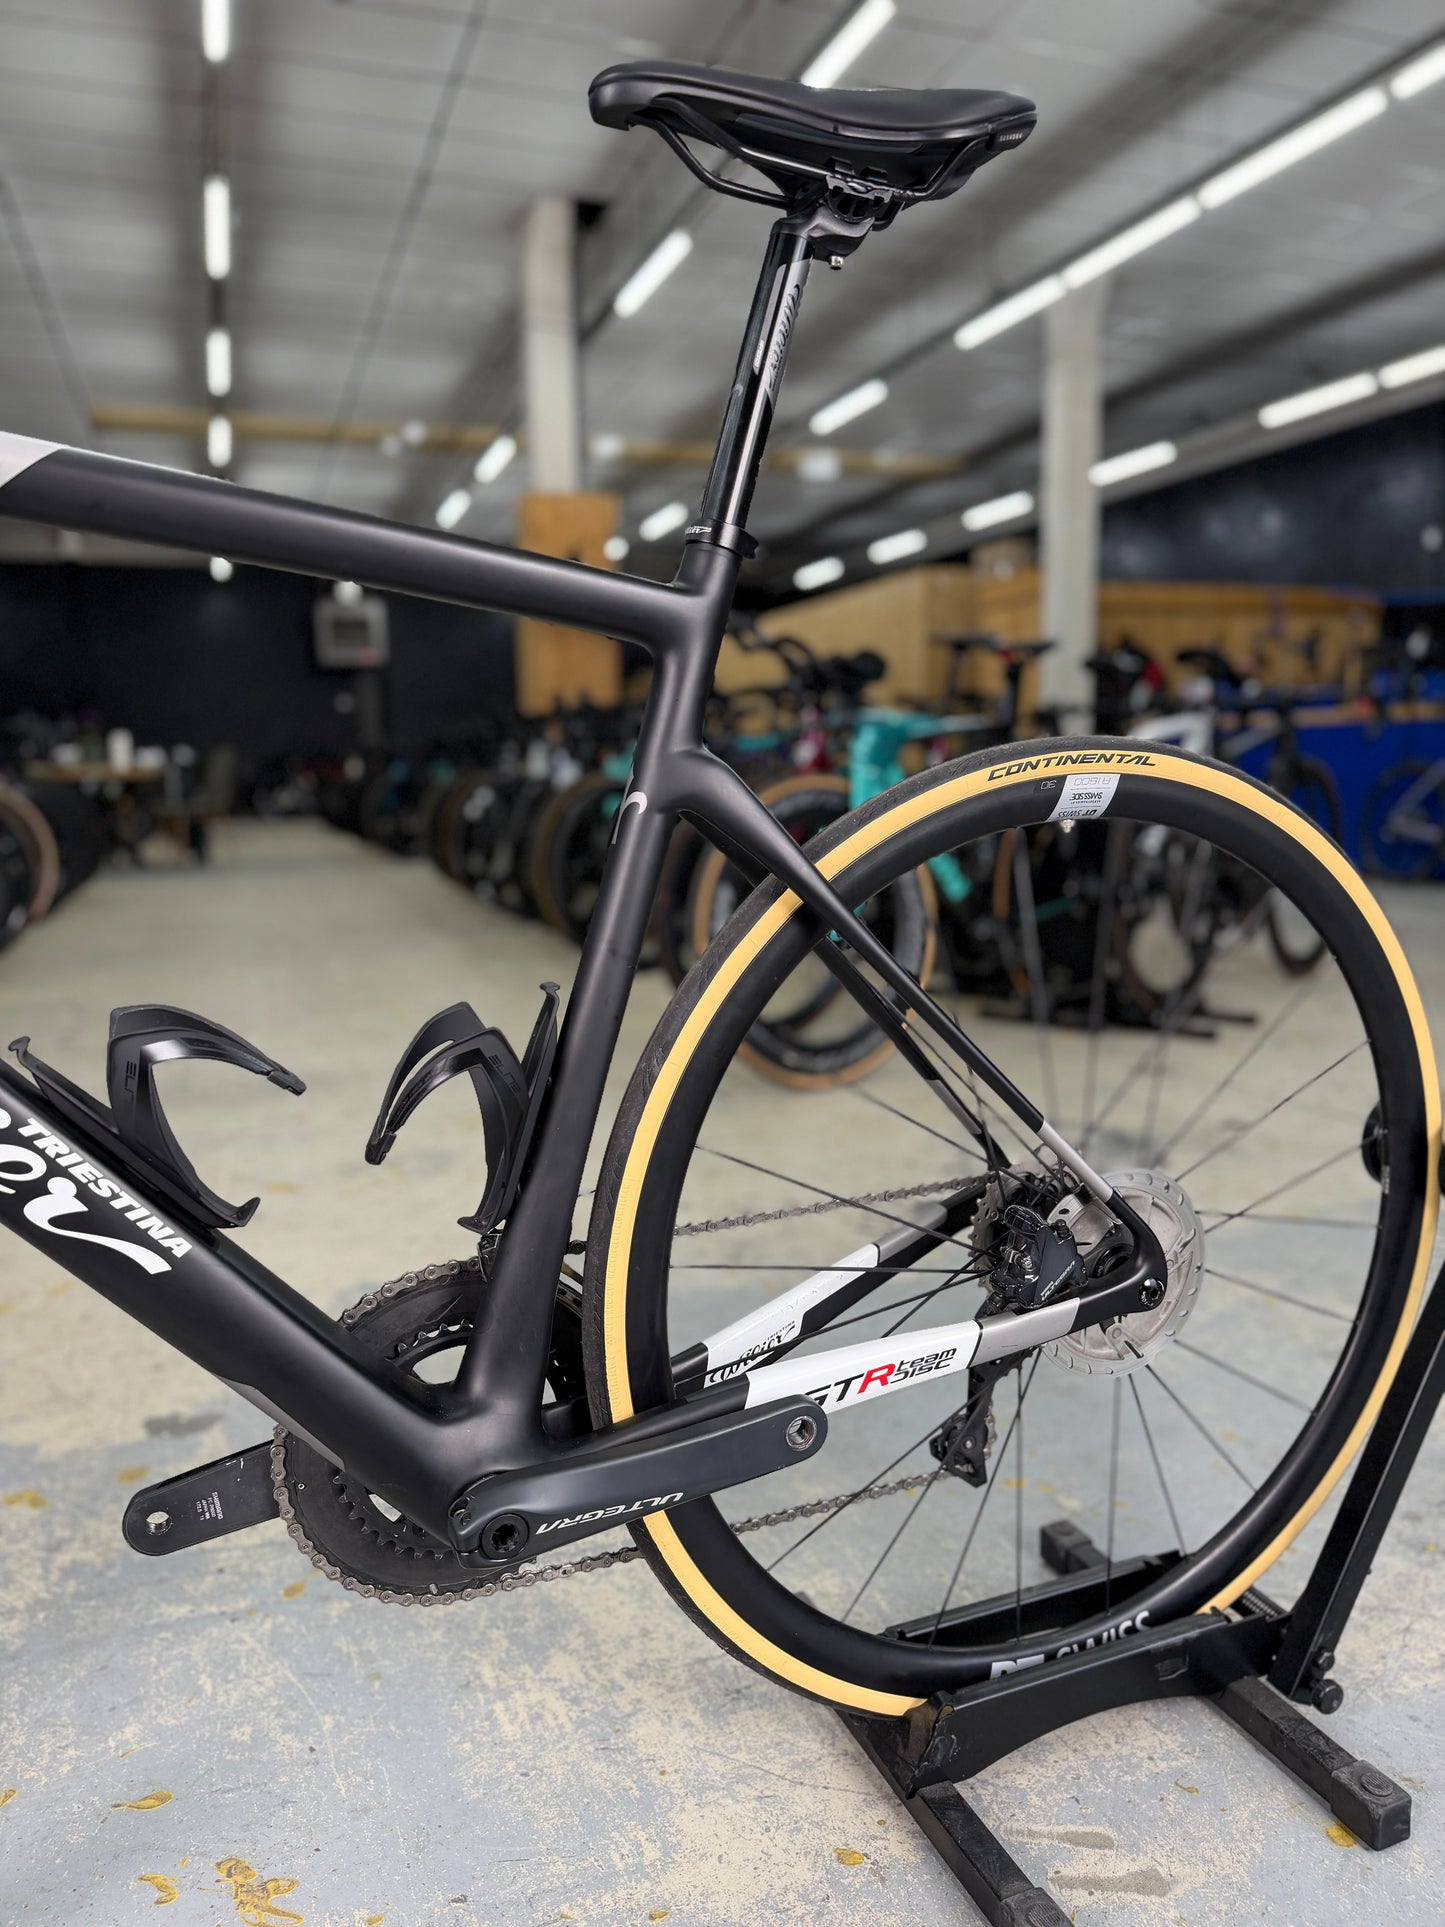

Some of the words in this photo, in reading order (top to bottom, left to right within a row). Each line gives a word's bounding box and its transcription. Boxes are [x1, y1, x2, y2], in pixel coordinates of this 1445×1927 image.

[987, 753, 1156, 782] CONTINENTAL
[1057, 809, 1082, 819] SWISS
[1082, 809, 1097, 817] DT
[17, 1117, 193, 1259] TRIESTINA
[890, 1356, 954, 1384] DISC
[896, 1348, 957, 1372] team
[535, 1492, 684, 1535] ULTEGRA
